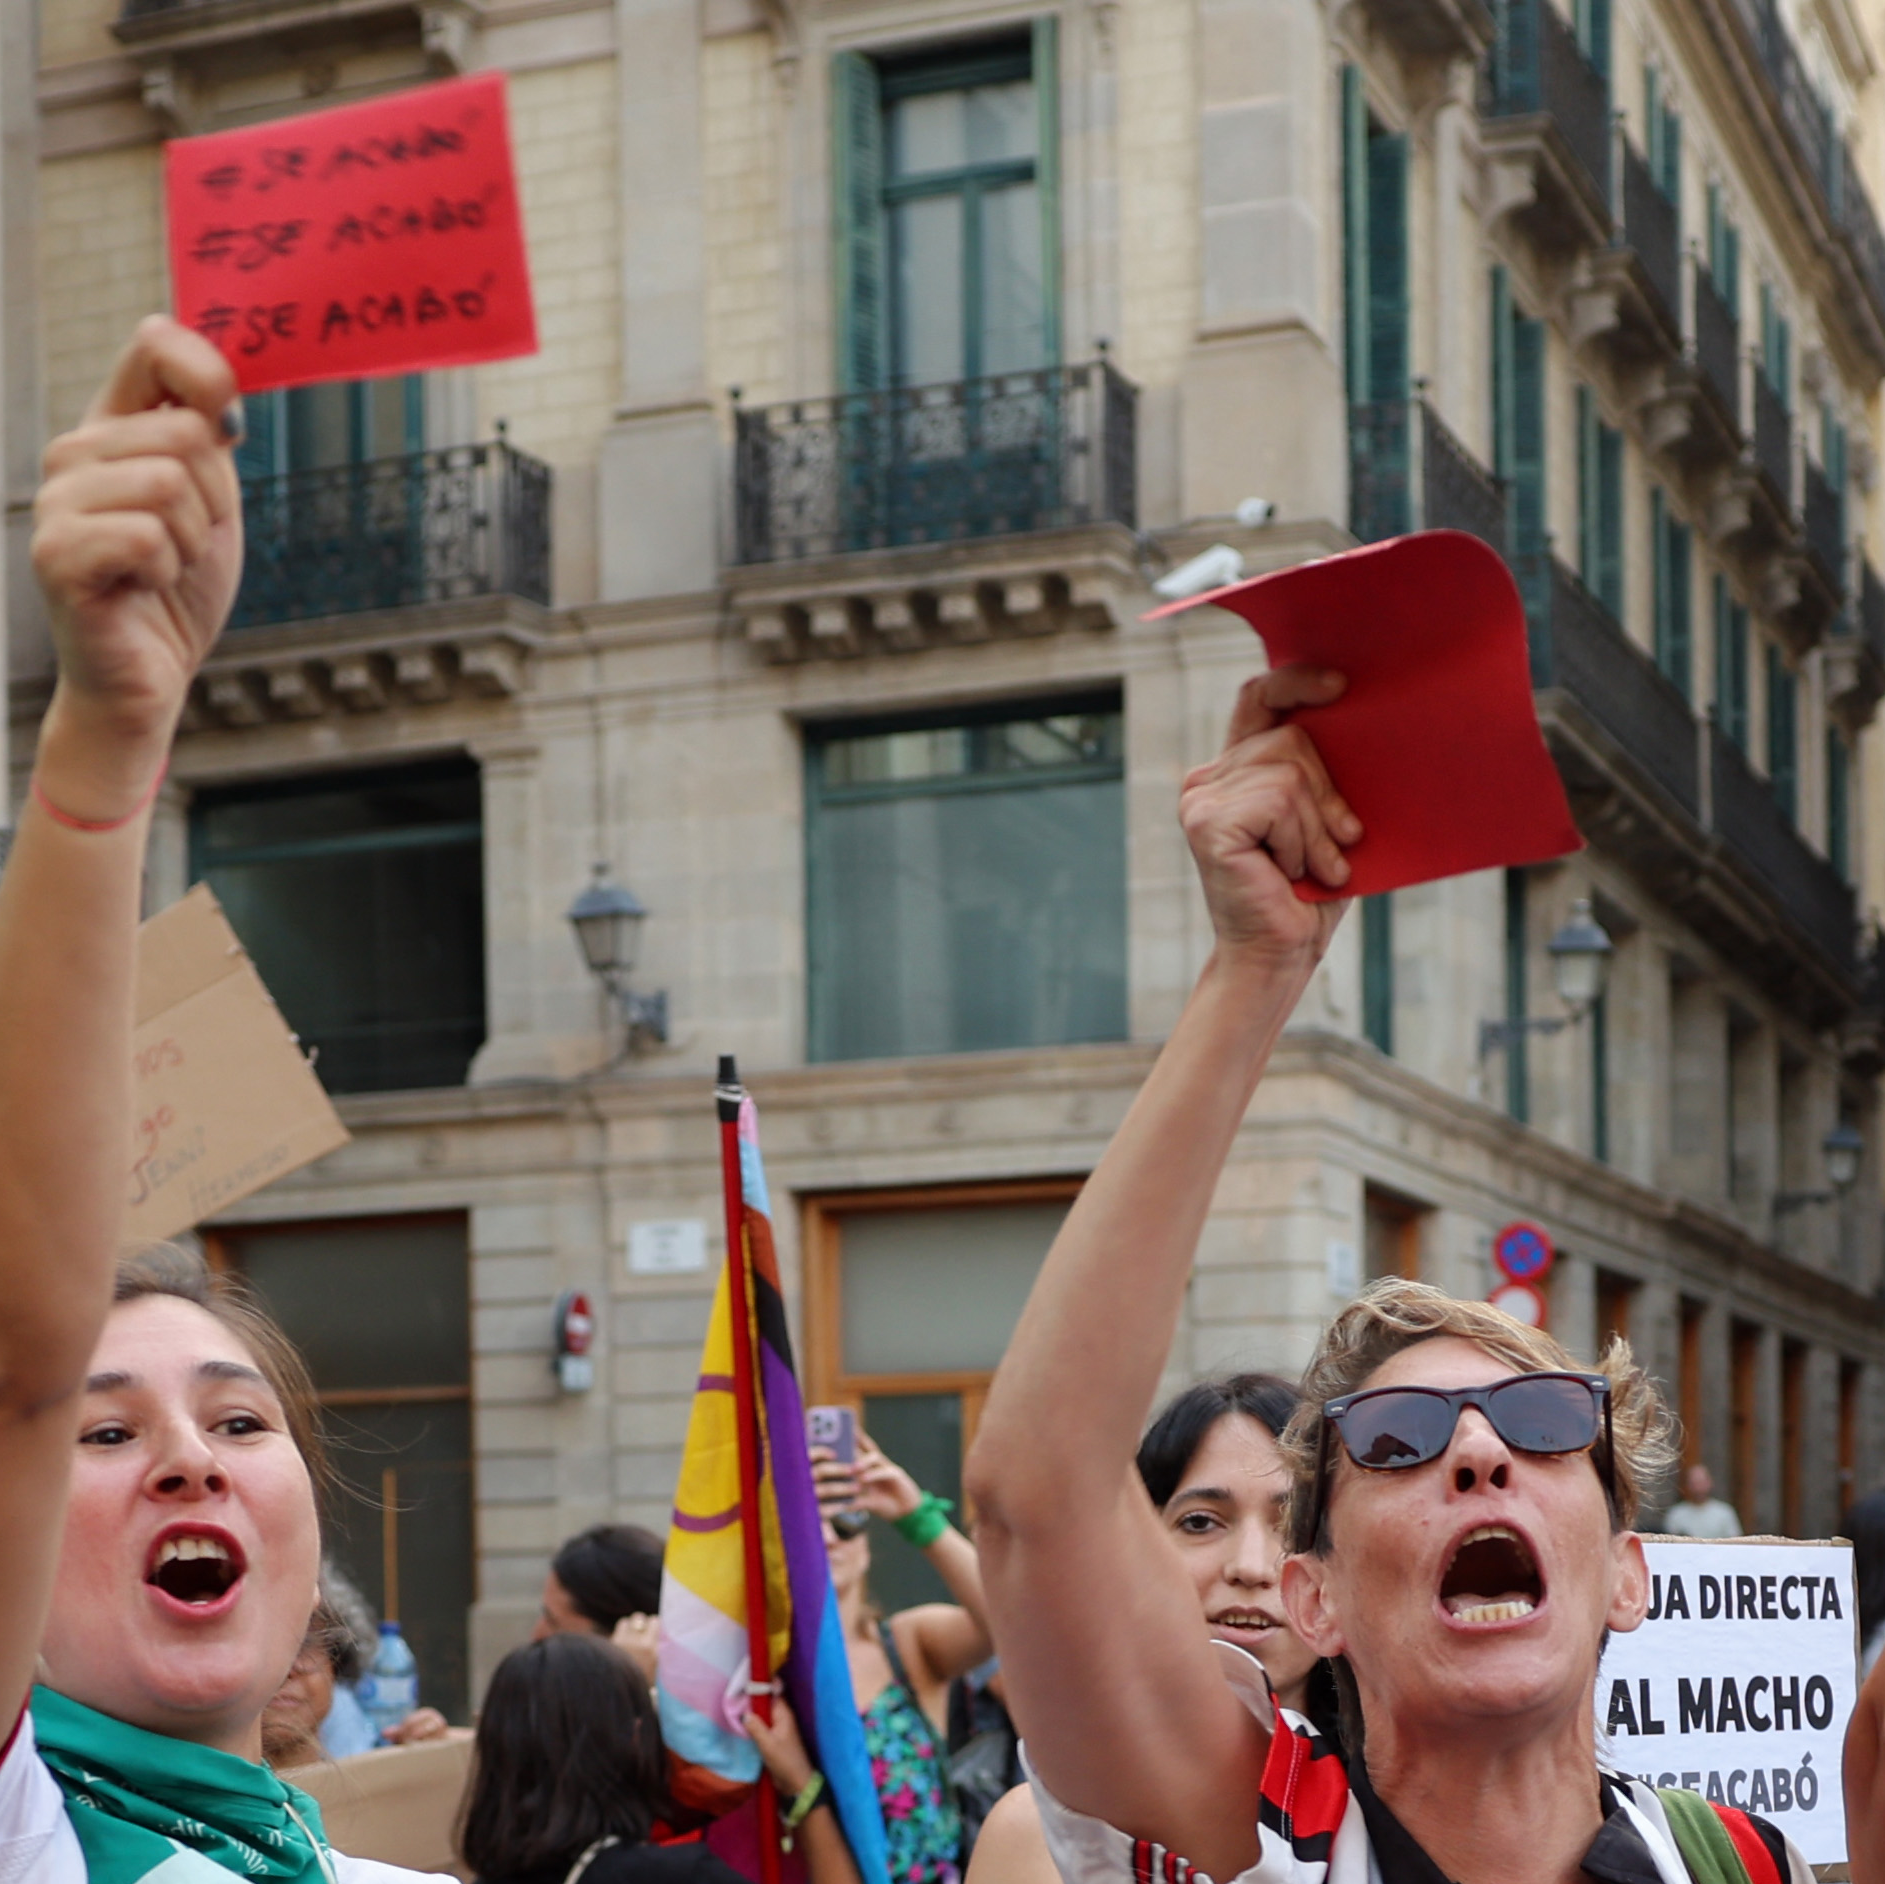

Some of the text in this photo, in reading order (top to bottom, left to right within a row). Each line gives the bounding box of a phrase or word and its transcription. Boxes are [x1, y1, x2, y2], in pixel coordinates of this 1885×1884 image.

[1648, 1574, 1844, 1621] JA DIRECTA
[1605, 1674, 1834, 1737] AL MACHO
